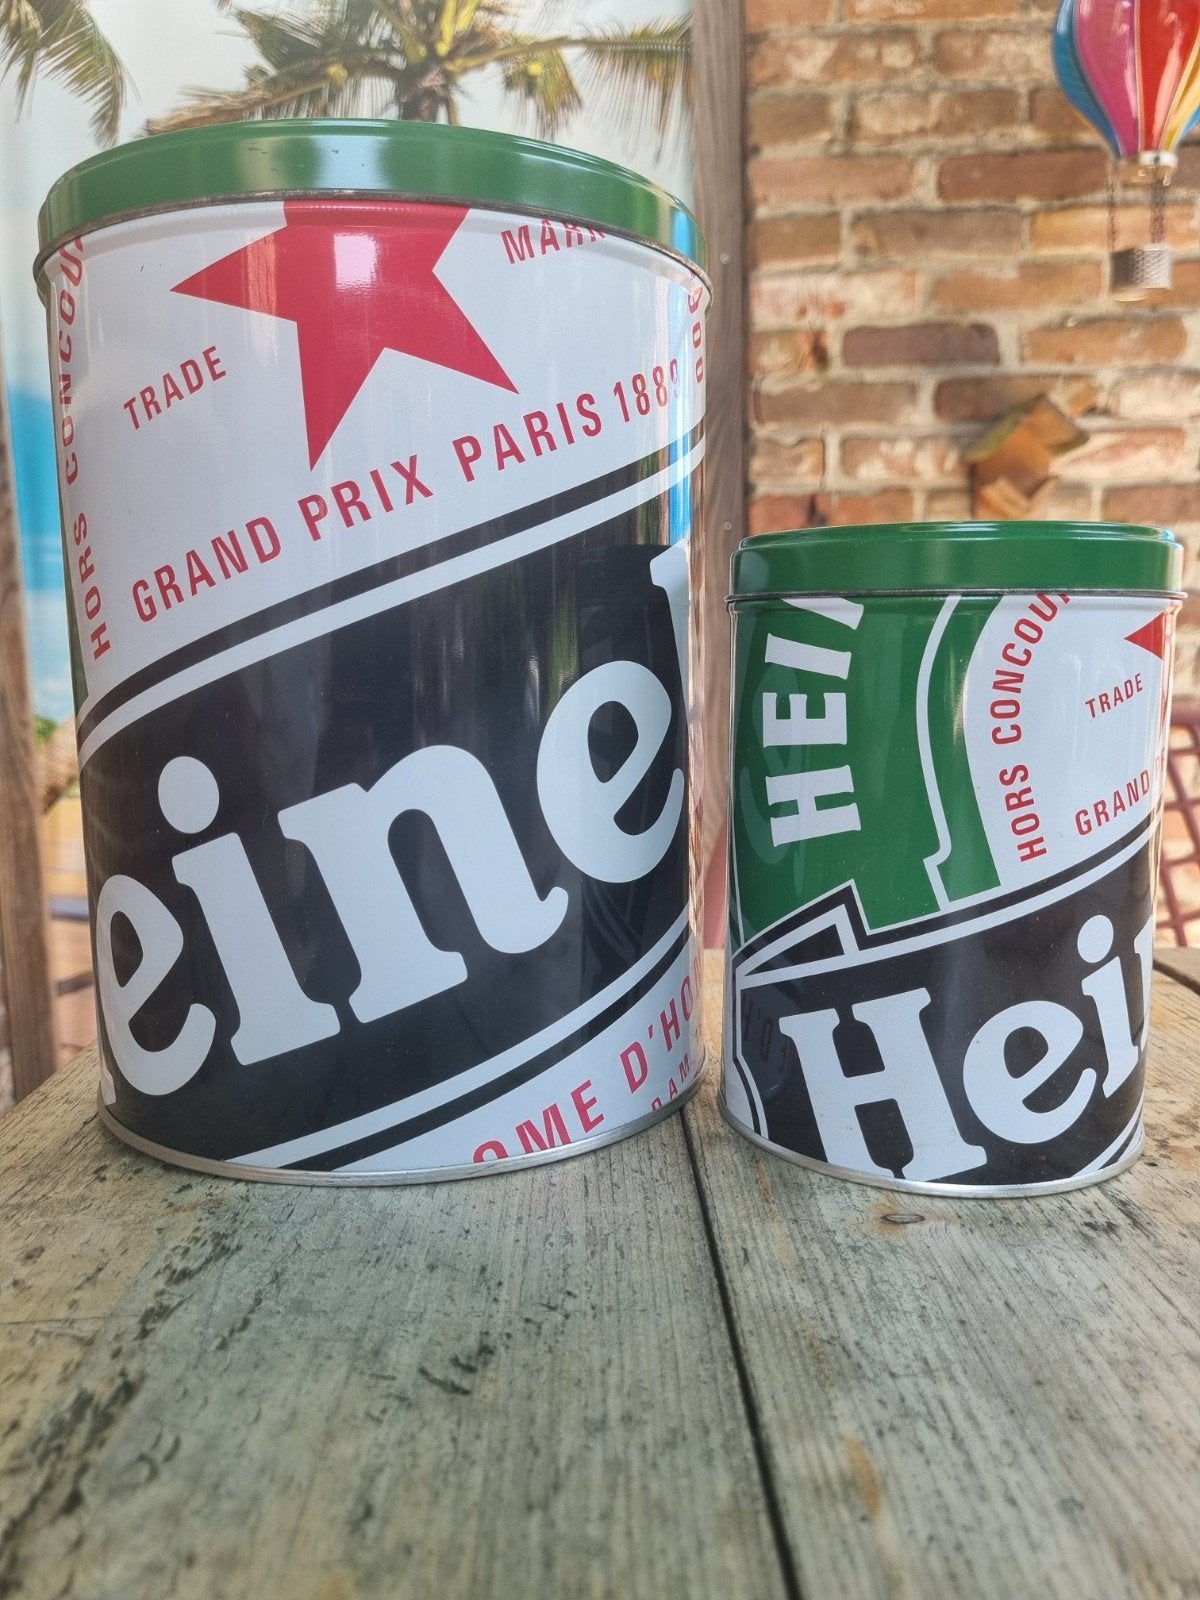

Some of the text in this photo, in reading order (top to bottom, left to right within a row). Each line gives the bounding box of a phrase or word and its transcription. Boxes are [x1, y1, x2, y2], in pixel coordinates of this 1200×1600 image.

[58, 235, 111, 661] HORS CONCOU
[123, 345, 226, 430] TRADE
[132, 516, 282, 622] GRAND
[297, 454, 434, 541] PRIX
[452, 393, 602, 482] PARIS
[991, 594, 1070, 862] HORS CONCOU
[1074, 769, 1150, 836] GRAND
[1085, 673, 1144, 718] TRADE
[96, 538, 692, 1106] eine
[779, 915, 1153, 1181] Hei
